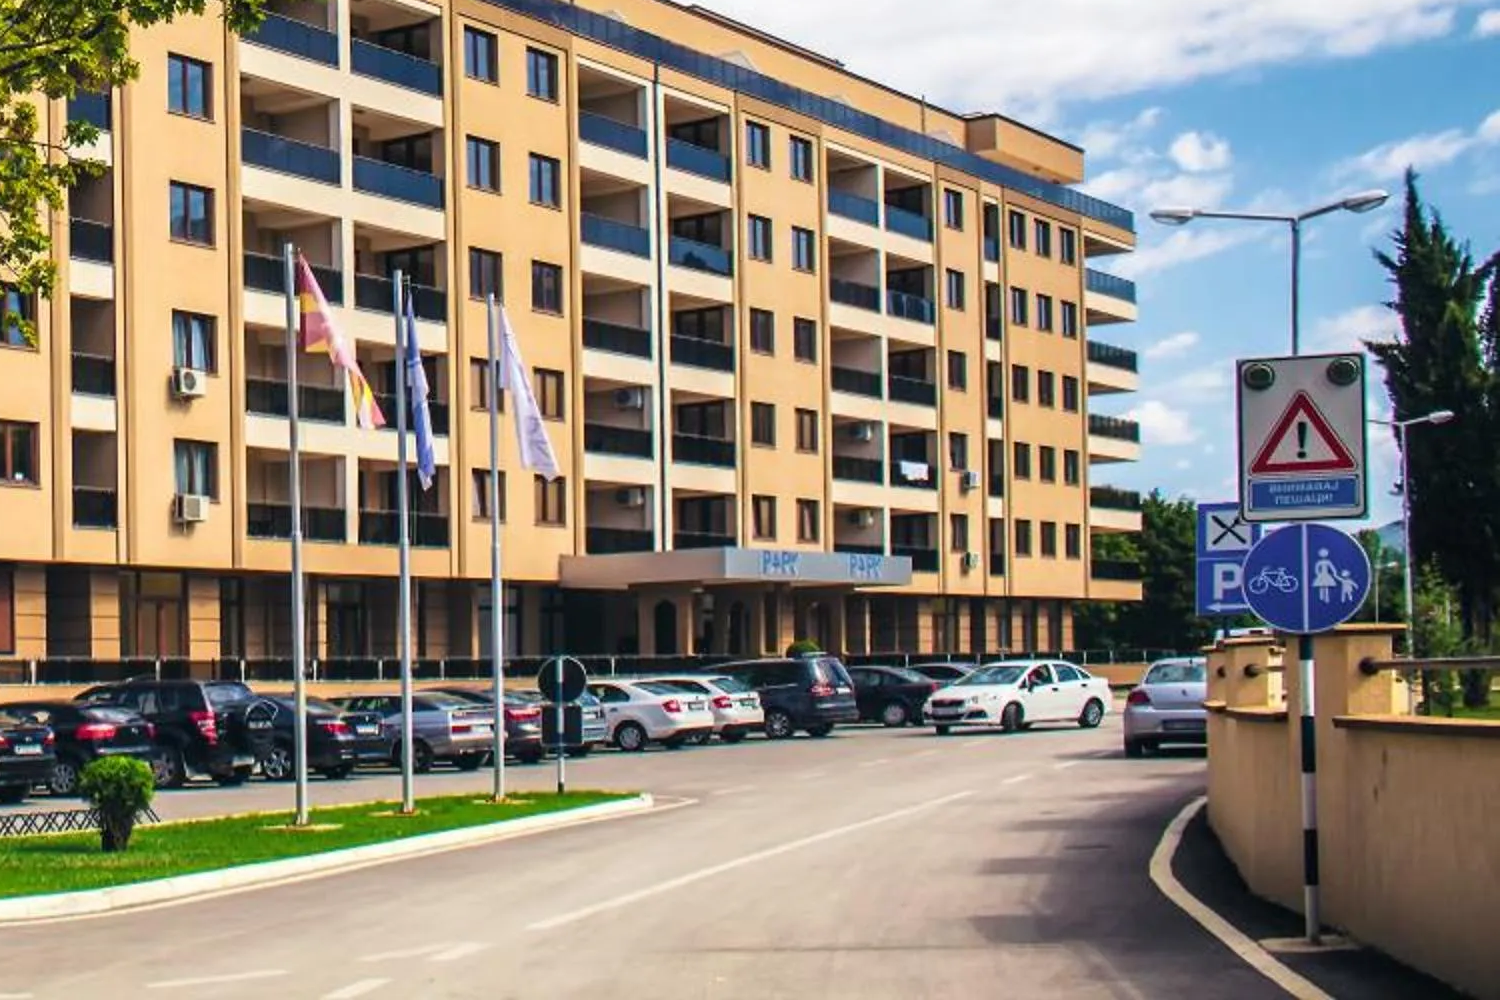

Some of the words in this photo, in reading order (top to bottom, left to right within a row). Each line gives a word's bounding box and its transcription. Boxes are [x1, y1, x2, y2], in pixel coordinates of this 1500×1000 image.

[762, 550, 799, 574] PARK
[849, 553, 883, 578] PARK
[1213, 563, 1243, 600] P
